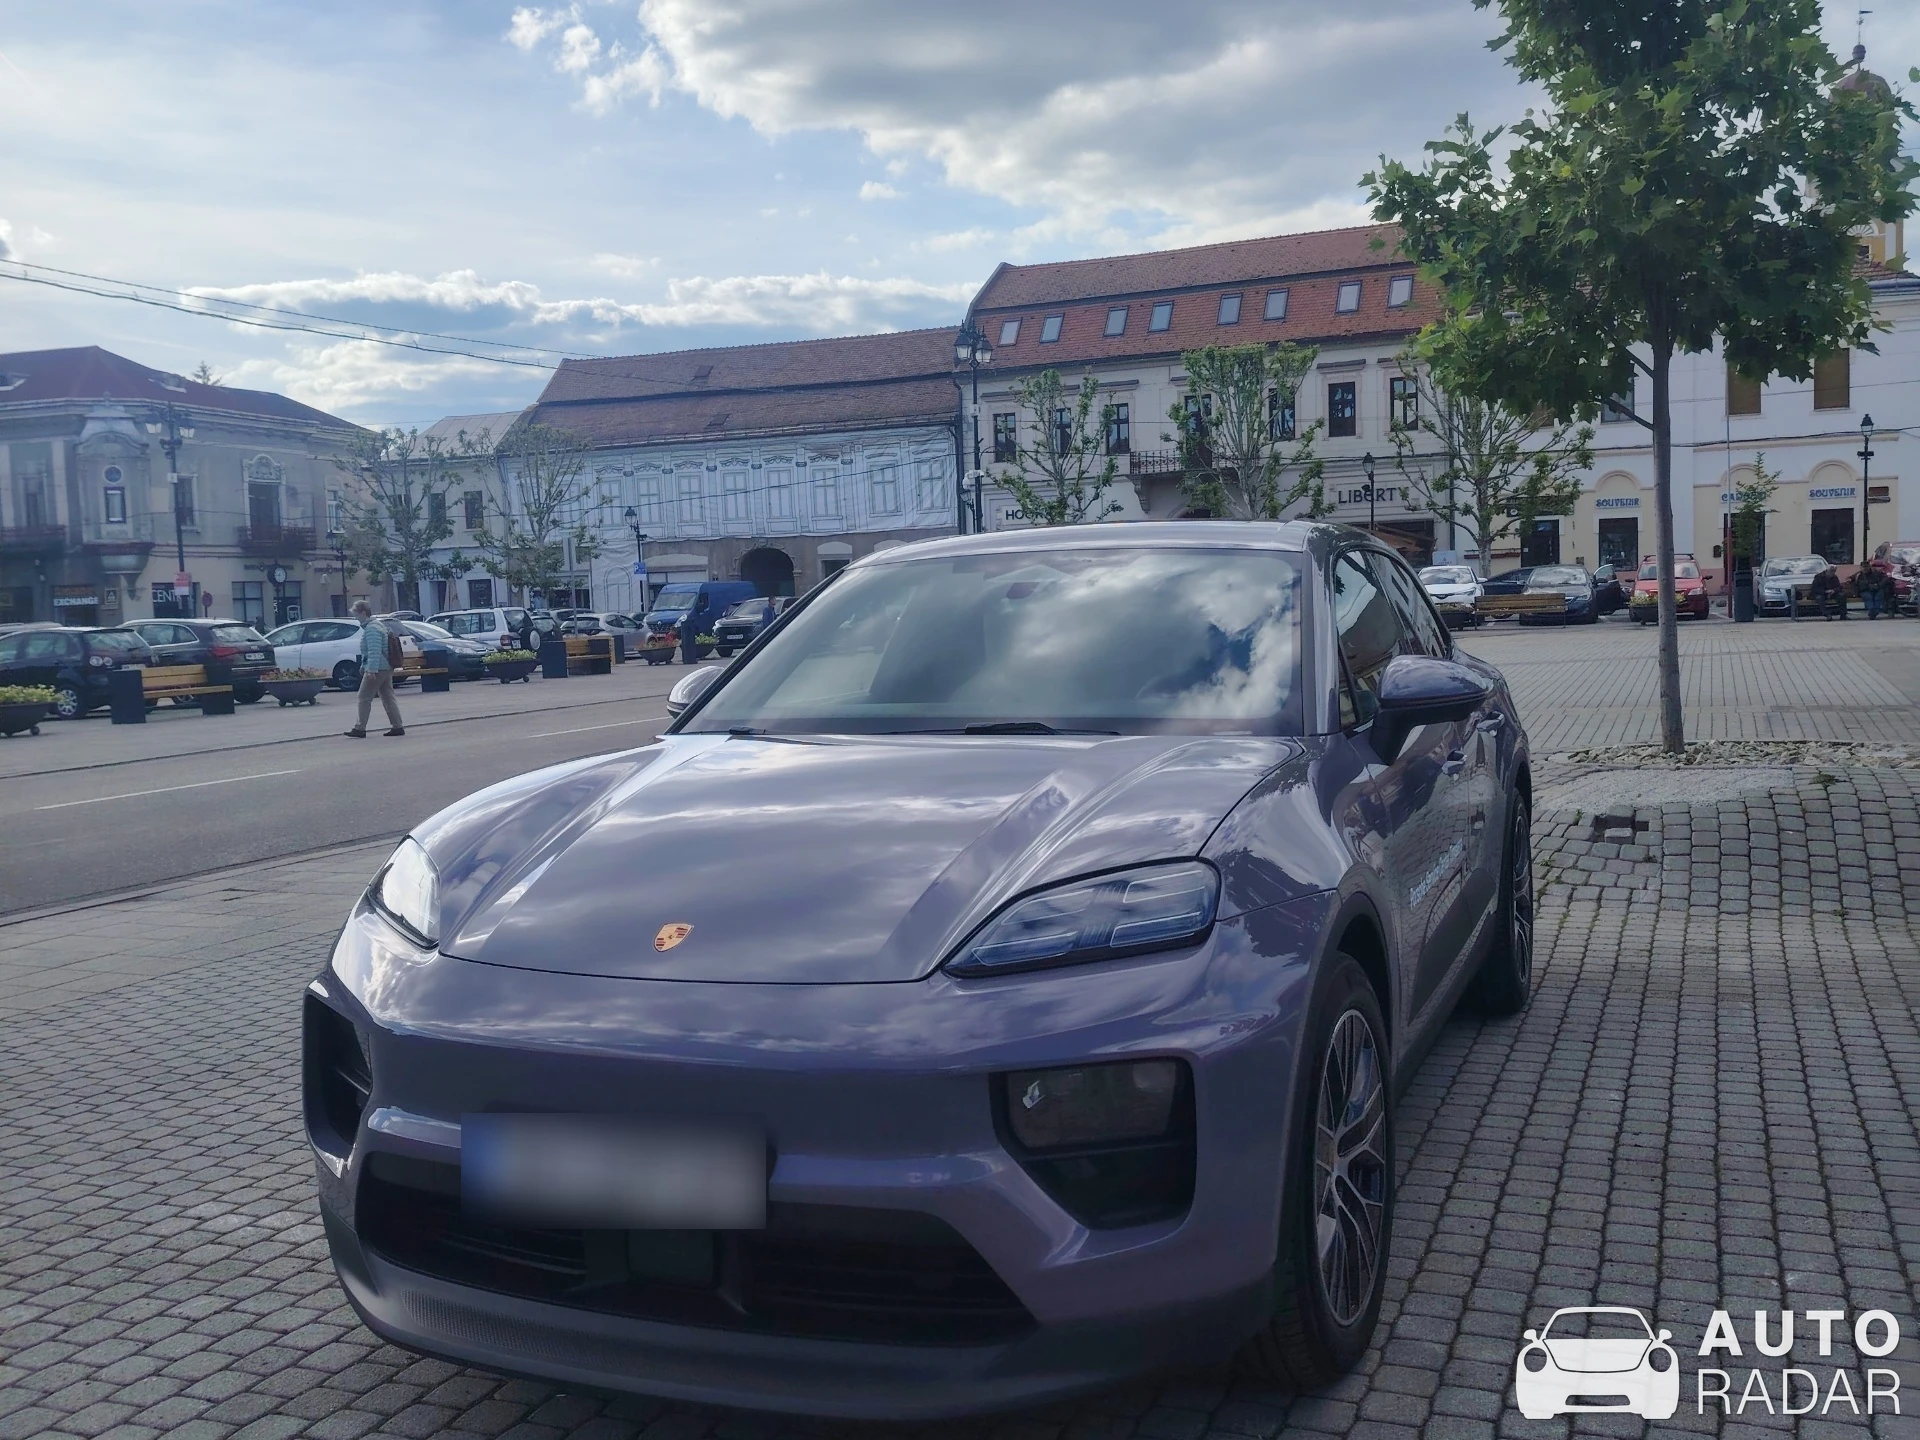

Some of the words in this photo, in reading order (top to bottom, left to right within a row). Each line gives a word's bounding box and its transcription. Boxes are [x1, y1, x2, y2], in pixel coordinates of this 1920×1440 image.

[1809, 487, 1856, 498] SOUVENIR
[1595, 497, 1640, 508] SOUVENIR
[53, 596, 99, 606] EXCHANGE
